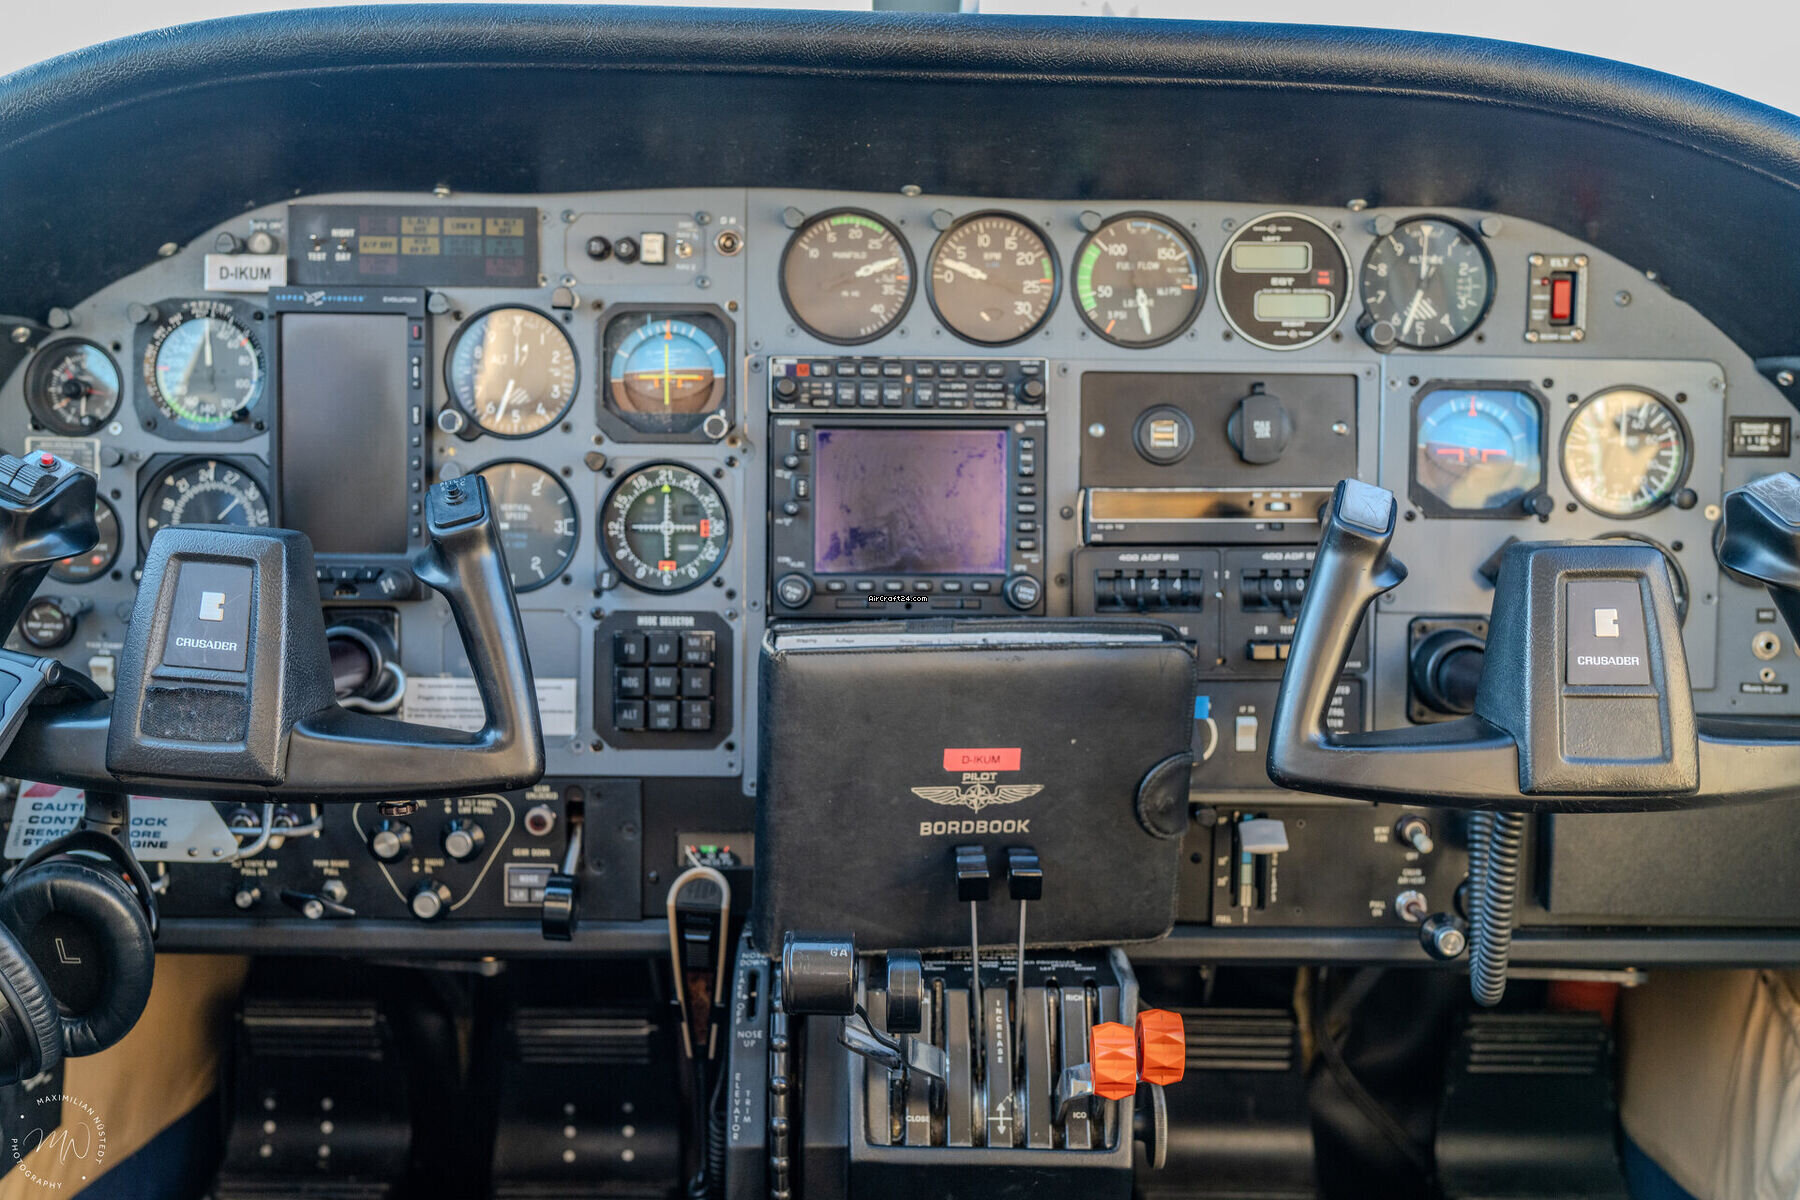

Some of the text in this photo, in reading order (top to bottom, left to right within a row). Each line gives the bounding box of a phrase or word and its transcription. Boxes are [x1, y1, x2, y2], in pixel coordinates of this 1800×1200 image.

[826, 231, 838, 243] 15
[848, 228, 863, 240] 20
[977, 233, 991, 248] 10
[1004, 235, 1018, 250] 15
[1394, 242, 1404, 256] 9
[808, 247, 820, 259] 10
[955, 245, 967, 260] 5
[983, 252, 1002, 260] RPM
[1108, 243, 1128, 256] 100
[1157, 247, 1177, 260] 150
[308, 253, 326, 261] TEST
[1015, 251, 1035, 266] 20
[1549, 257, 1570, 268] ELT
[1137, 261, 1160, 270] FLOW
[1377, 262, 1388, 277] 8
[1458, 262, 1469, 276] 2
[219, 266, 272, 281] D-IKUM
[943, 270, 954, 283] 0
[1022, 279, 1041, 294] 25
[1097, 285, 1113, 298] 50
[1377, 289, 1387, 304] 7
[870, 303, 885, 314] 40
[1013, 300, 1032, 315] 30
[1391, 312, 1401, 326] 6
[1439, 313, 1450, 326] 4
[1415, 320, 1425, 335] 5
[473, 345, 483, 360] 8
[551, 350, 561, 364] 2
[550, 384, 560, 399] 3
[485, 401, 496, 415] 6
[535, 402, 546, 415] 4
[511, 409, 520, 423] 5
[658, 470, 673, 482] 21
[531, 481, 542, 496] 2
[530, 556, 541, 570] 2
[1118, 553, 1179, 561] 400 ADF PRI
[1262, 552, 1283, 561] 400
[1284, 552, 1305, 561] ADF
[1150, 578, 1159, 591] 2
[1173, 578, 1181, 591] 4
[1274, 579, 1304, 592] 0 0
[637, 616, 695, 627] MODE SELECTOR
[175, 637, 238, 652] CRUSADER
[624, 643, 670, 655] FD AP
[1577, 655, 1640, 666] CRUSADER
[621, 677, 639, 688] HDG
[655, 677, 672, 688] NAV
[1764, 685, 1783, 694] Input
[622, 709, 638, 721] ALT
[961, 755, 1001, 765] D-IKUM
[962, 772, 998, 781] PILOT
[31, 802, 84, 812] CAUTI
[28, 815, 168, 827] CONT OCK
[919, 819, 1031, 836] BORDBOOK
[130, 830, 161, 838] ORE
[131, 840, 168, 849] GINE
[519, 874, 539, 883] NOSE
[55, 938, 81, 963] L
[830, 947, 848, 957] GA
[737, 969, 745, 999] TAKE
[736, 1003, 746, 1025] OFF
[737, 1031, 763, 1039] NOSE
[732, 1073, 741, 1141] ELEVATOR
[743, 1090, 752, 1123] TRIM
[905, 1115, 930, 1123] CLOSE
[1072, 1111, 1087, 1119] ICO
